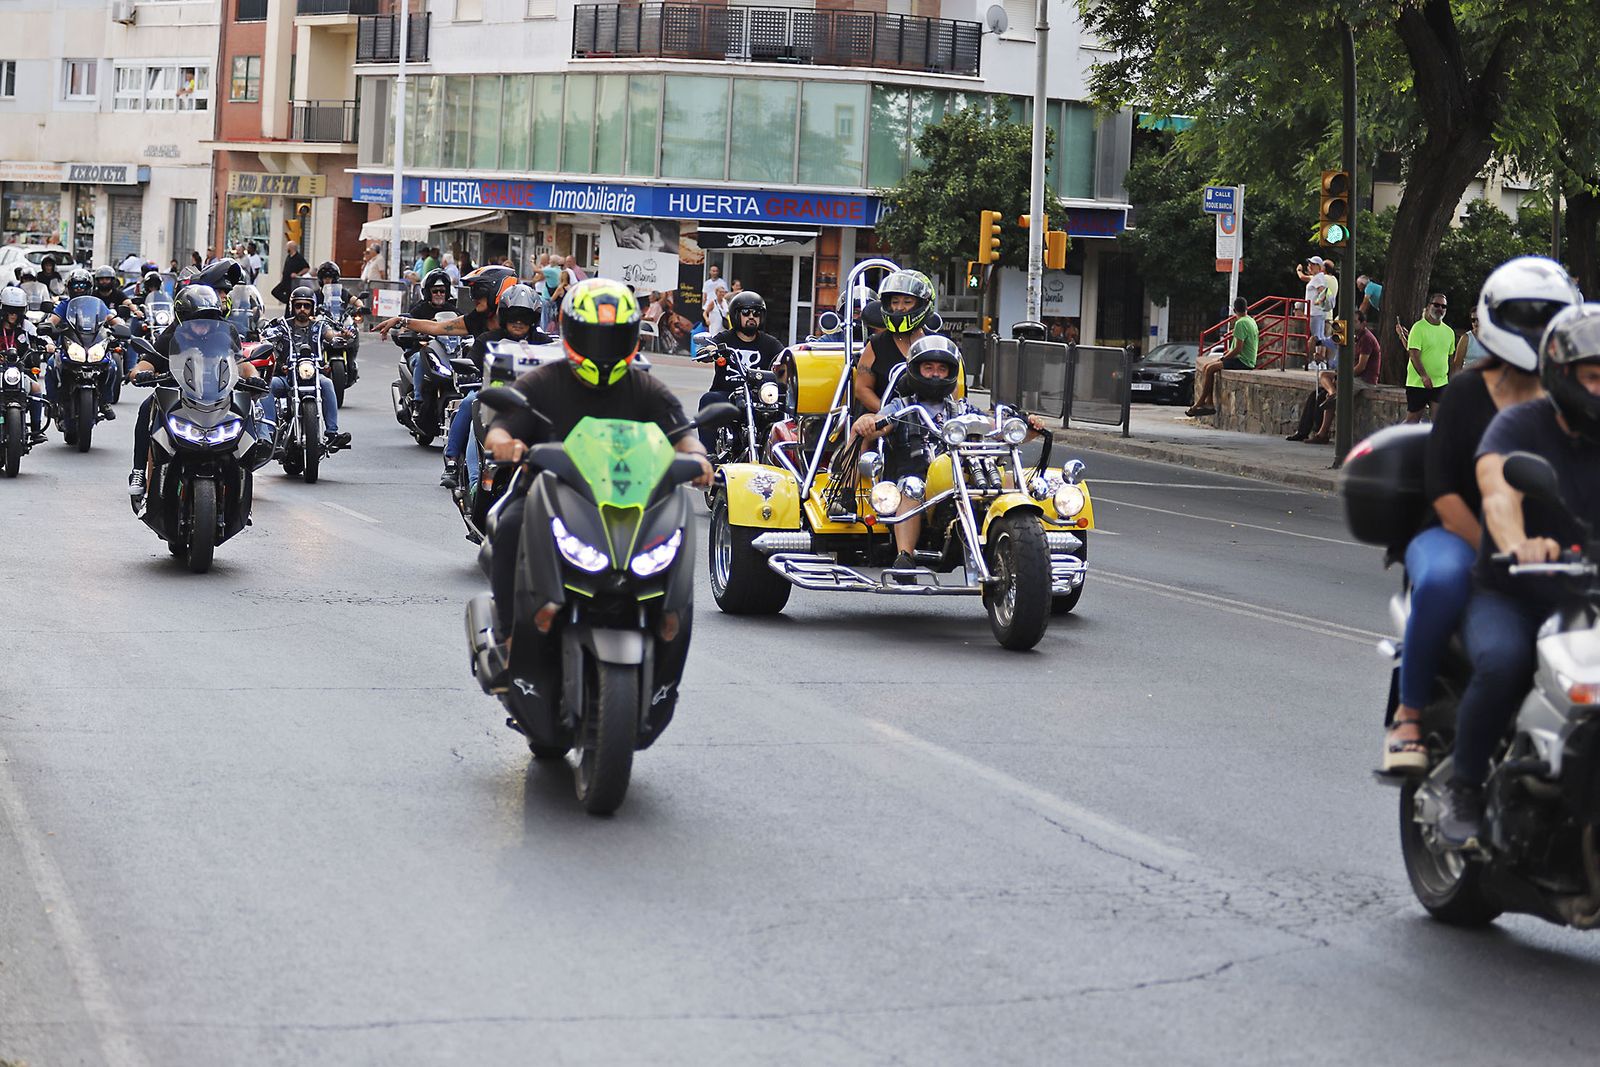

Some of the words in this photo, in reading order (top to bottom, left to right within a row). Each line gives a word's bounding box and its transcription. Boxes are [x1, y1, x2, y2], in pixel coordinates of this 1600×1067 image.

[260, 175, 300, 193] KETA
[549, 184, 635, 213] Inmobiliaria
[669, 193, 760, 216] HUERTA
[765, 198, 863, 219] GRANDE
